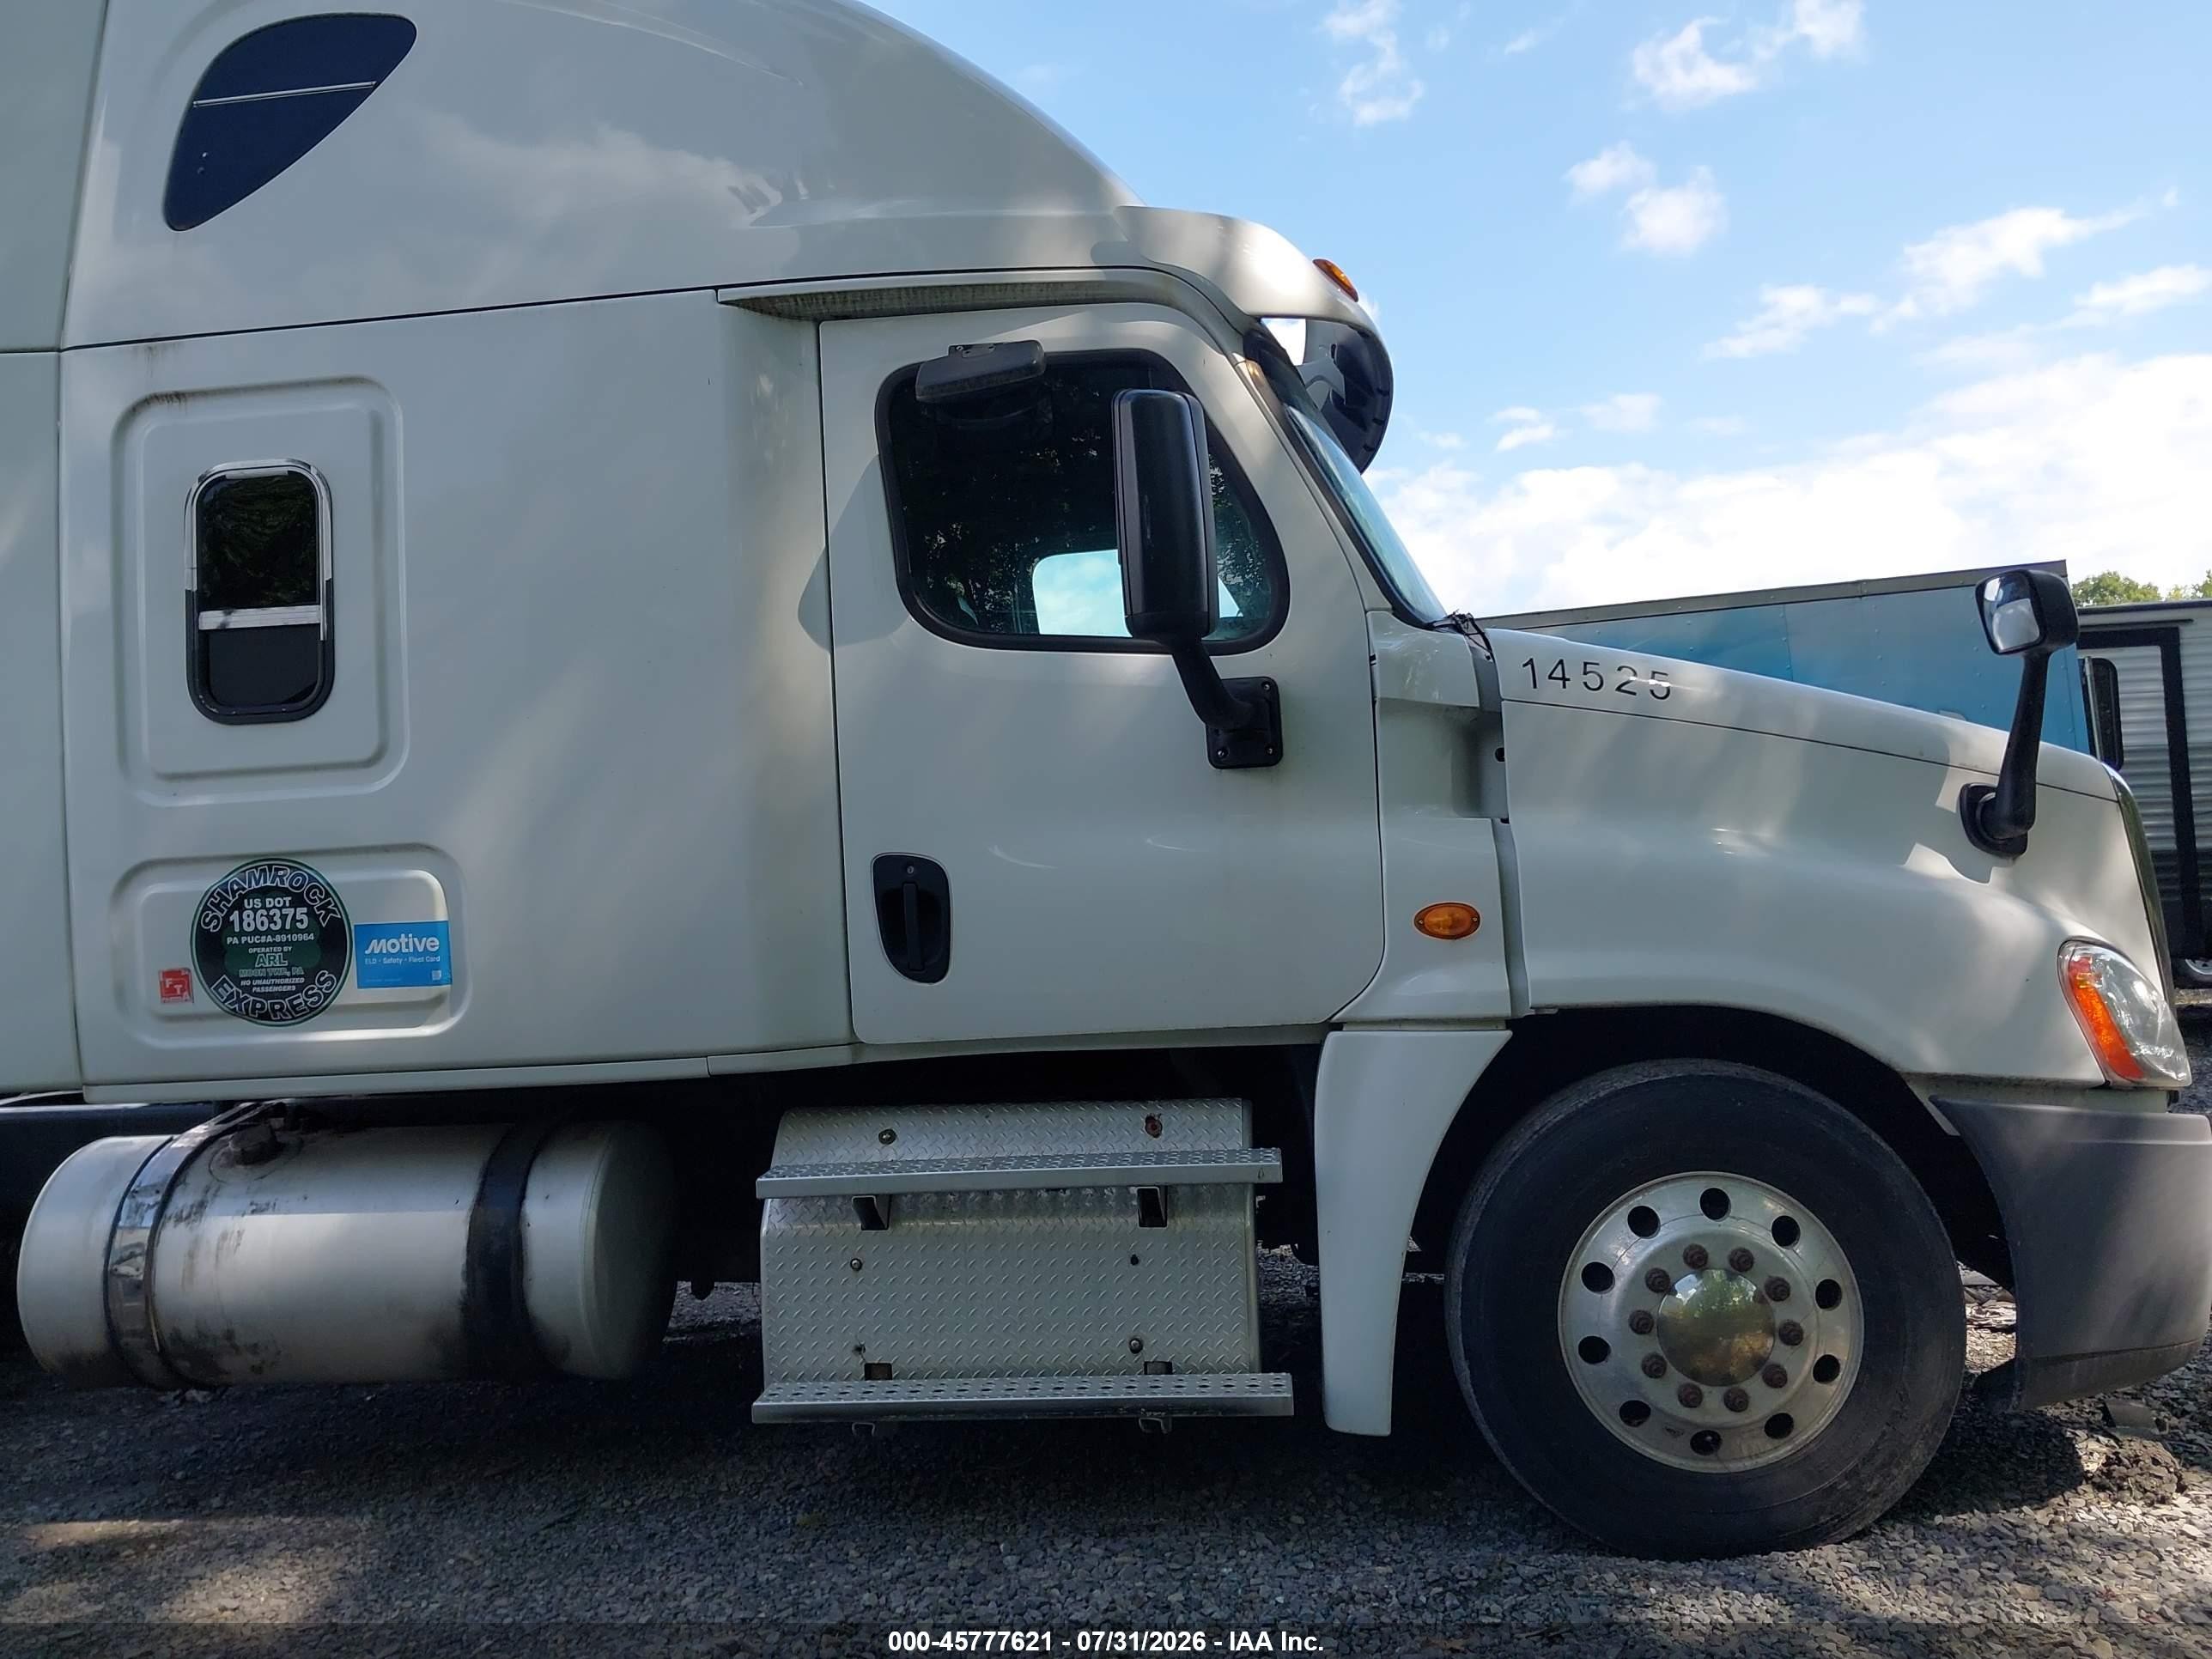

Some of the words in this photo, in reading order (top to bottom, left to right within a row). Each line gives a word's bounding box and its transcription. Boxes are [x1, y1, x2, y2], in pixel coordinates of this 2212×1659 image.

[1522, 657, 1671, 700] 14525
[201, 865, 342, 933] SHAMROCK
[244, 898, 262, 908] US
[265, 896, 292, 908] DOT
[229, 907, 309, 933] 186375
[227, 936, 240, 945] PA
[255, 952, 289, 968] ARL
[252, 977, 305, 986] UNAUTHORIZED
[252, 985, 296, 994] PASSENGERS
[210, 969, 337, 1020] EXPRESS
